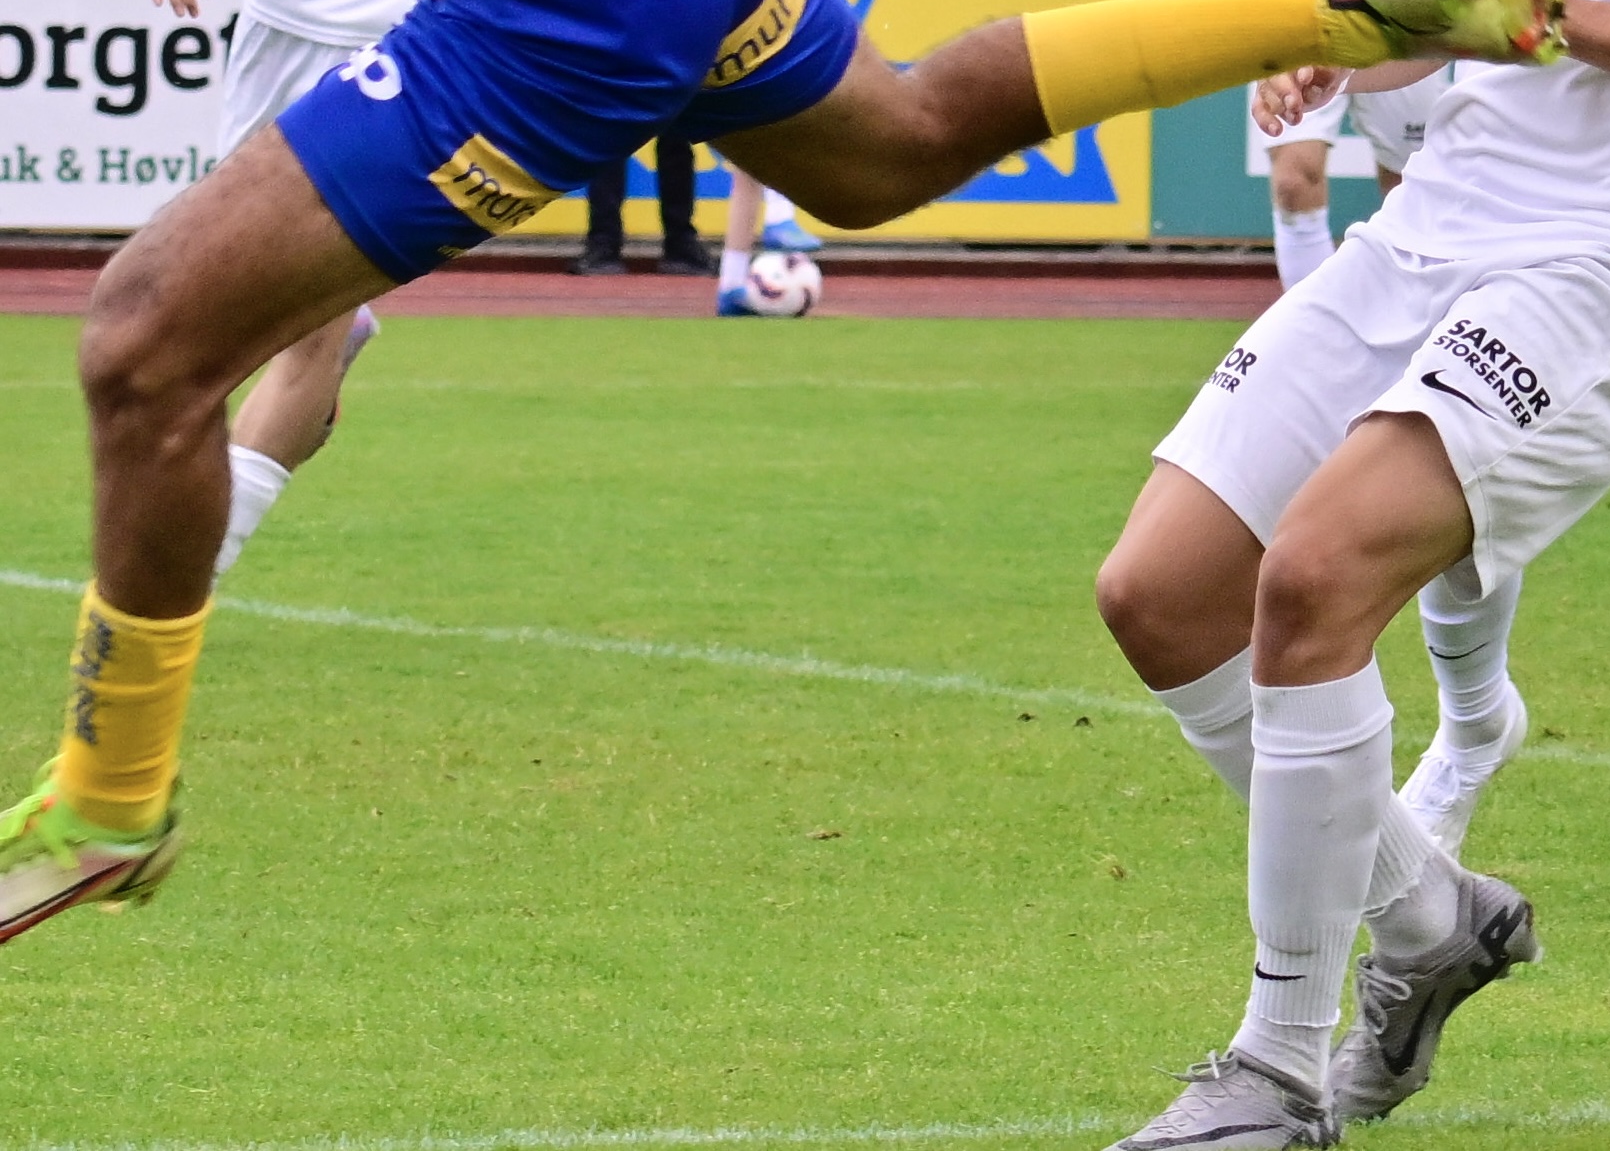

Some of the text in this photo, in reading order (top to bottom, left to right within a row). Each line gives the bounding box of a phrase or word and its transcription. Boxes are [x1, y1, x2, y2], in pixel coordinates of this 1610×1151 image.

[56, 148, 83, 182] &
[1433, 335, 1534, 430] STORSENTER
[1447, 318, 1551, 418] SARTOR
